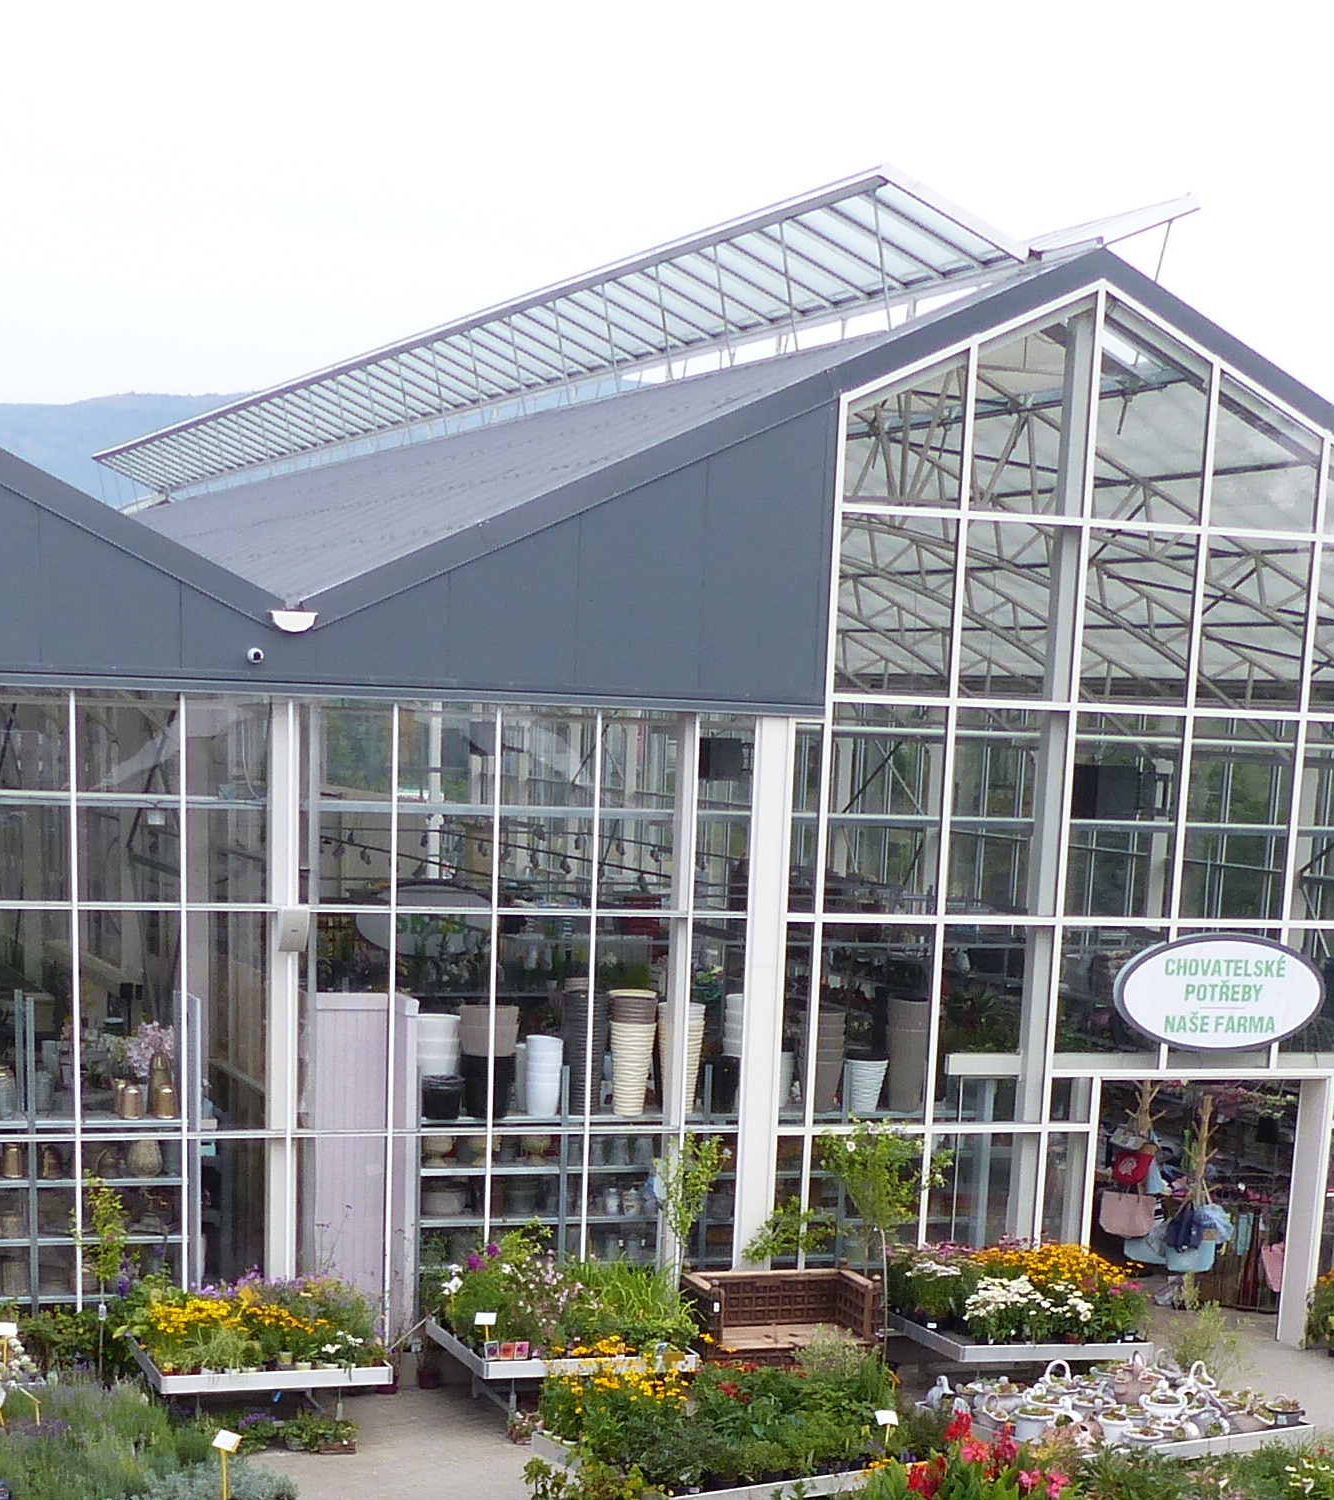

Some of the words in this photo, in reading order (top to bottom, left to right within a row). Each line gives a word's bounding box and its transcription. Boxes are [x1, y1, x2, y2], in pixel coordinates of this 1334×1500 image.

[1164, 954, 1286, 978] CHOVATELSKÉ
[1183, 980, 1264, 1002] POTŘEBY
[1163, 1011, 1210, 1034] NAŠE
[1214, 1015, 1276, 1034] FARMA
